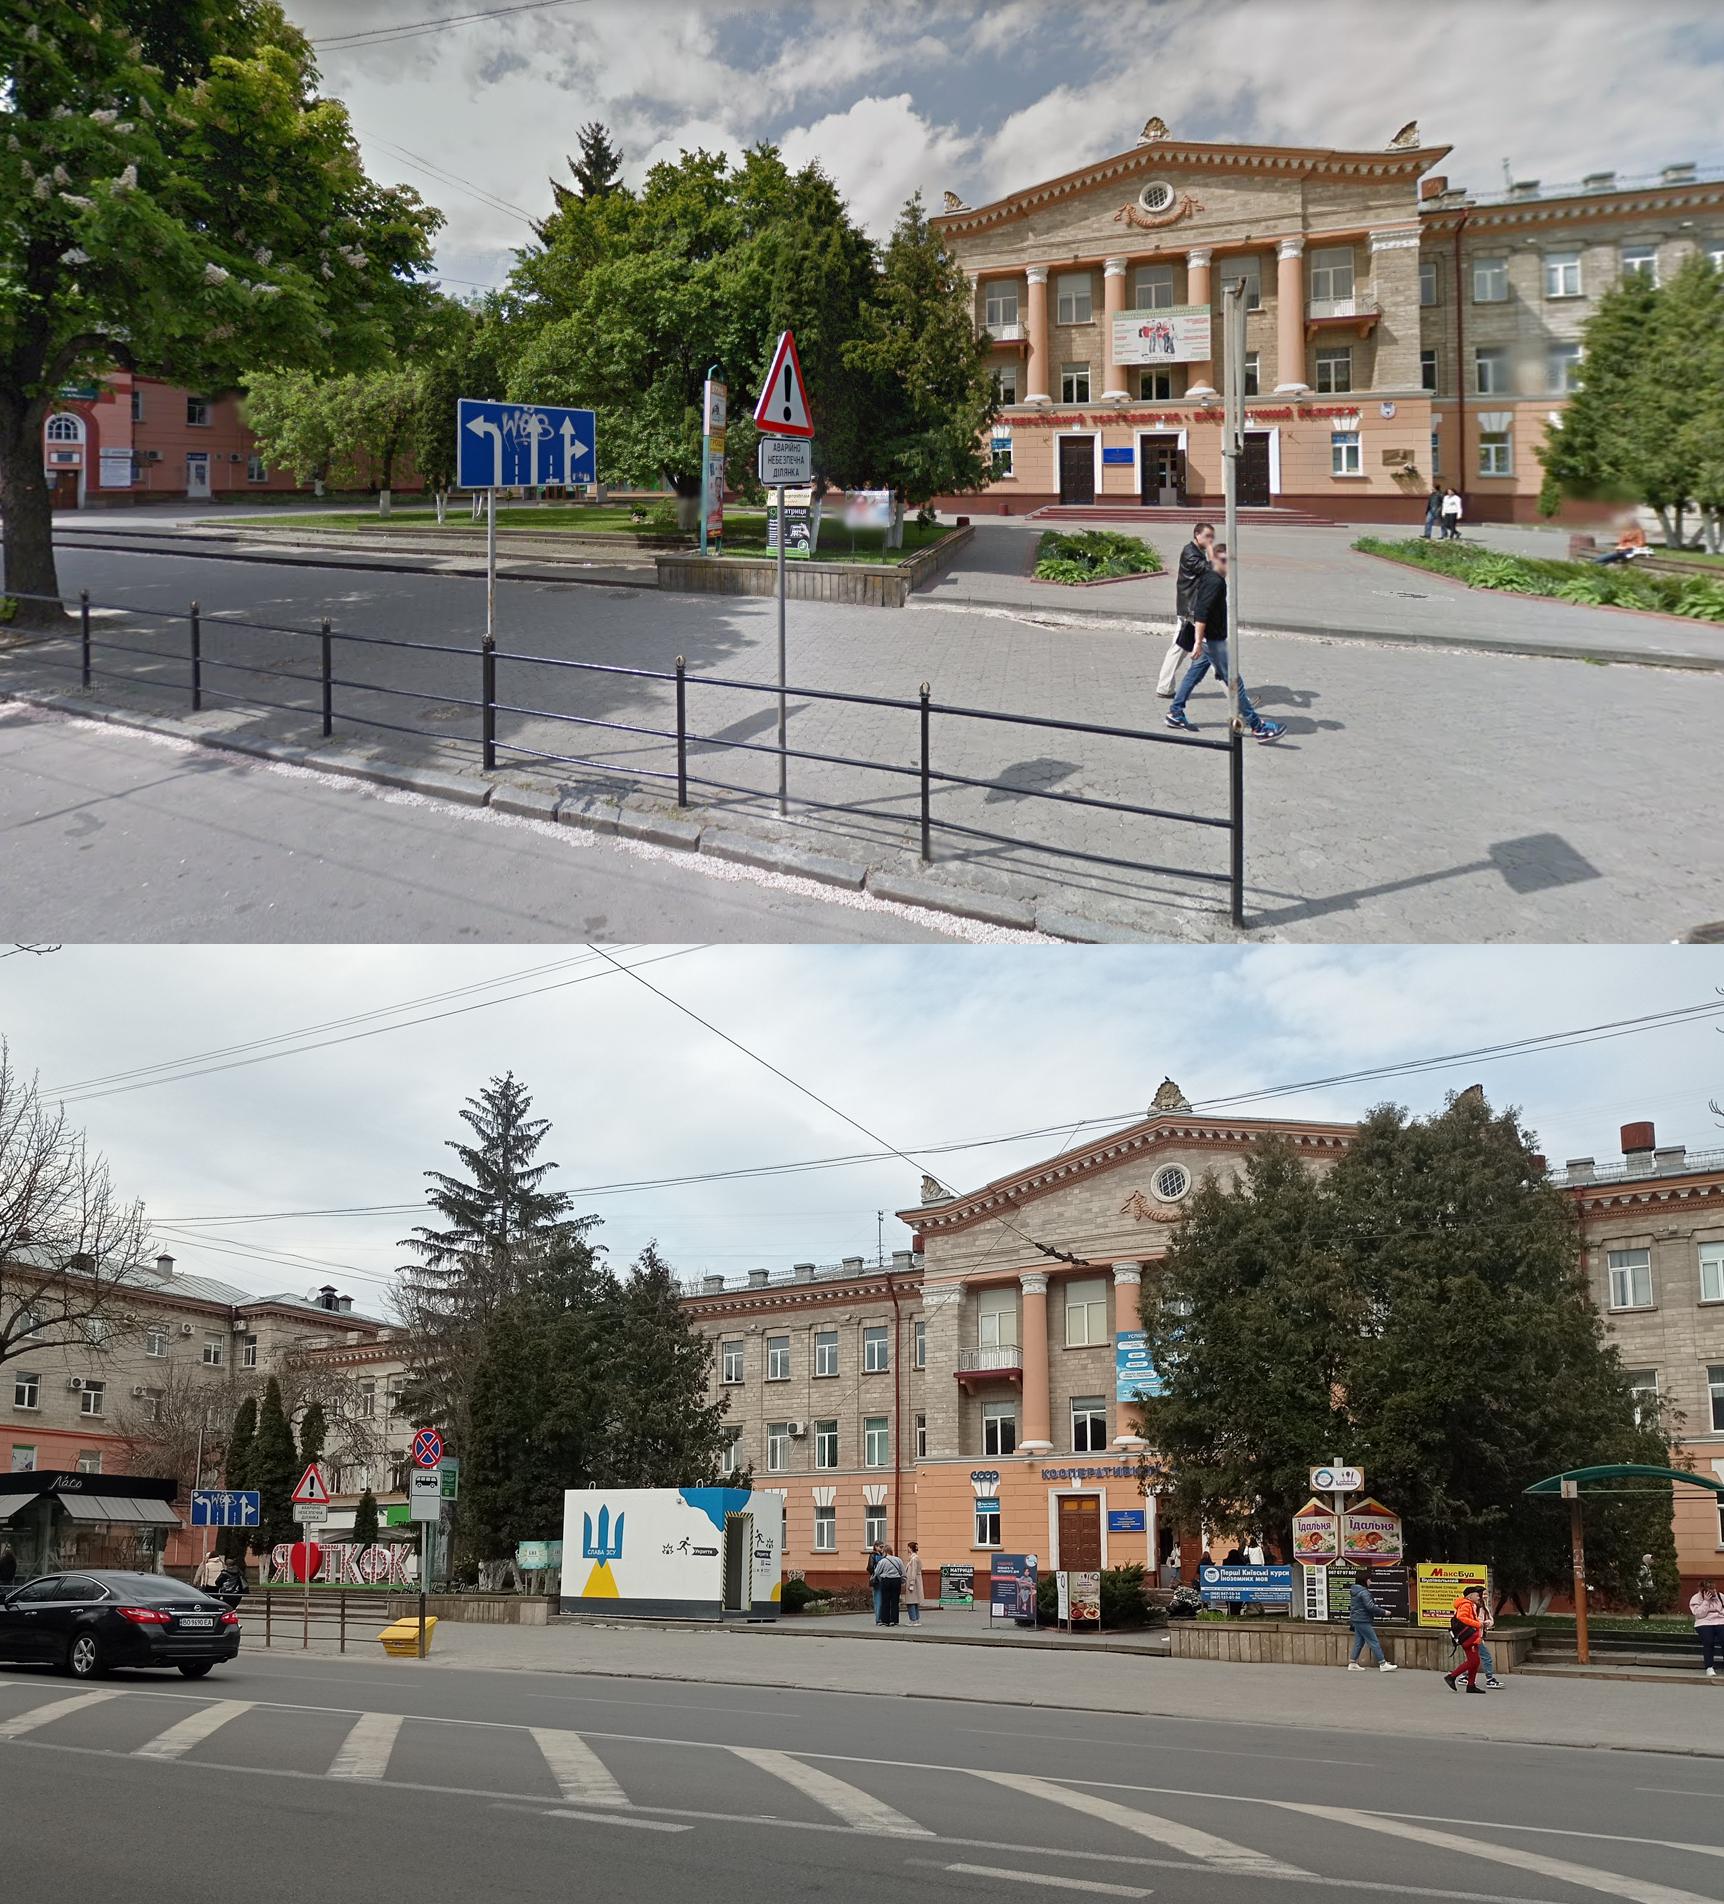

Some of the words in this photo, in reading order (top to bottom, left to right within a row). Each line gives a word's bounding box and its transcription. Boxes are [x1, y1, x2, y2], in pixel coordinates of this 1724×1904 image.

[993, 412, 1085, 426] ООПЕРАТИВНИЙ
[1091, 411, 1181, 424] ТОРГОВЕЛЬНО
[773, 443, 802, 453] АВАРІЙНО
[768, 455, 805, 465] НЕБЕЗПЕЧНА
[773, 468, 800, 479] ДІЛЯНКА
[1297, 1519, 1331, 1532] Їдальня
[1348, 1516, 1394, 1531] Їдальня
[271, 1543, 294, 1583] Я
[318, 1543, 415, 1585] ТКФК
[1220, 1569, 1240, 1577] Перші
[1430, 1568, 1475, 1578] МаксБуд
